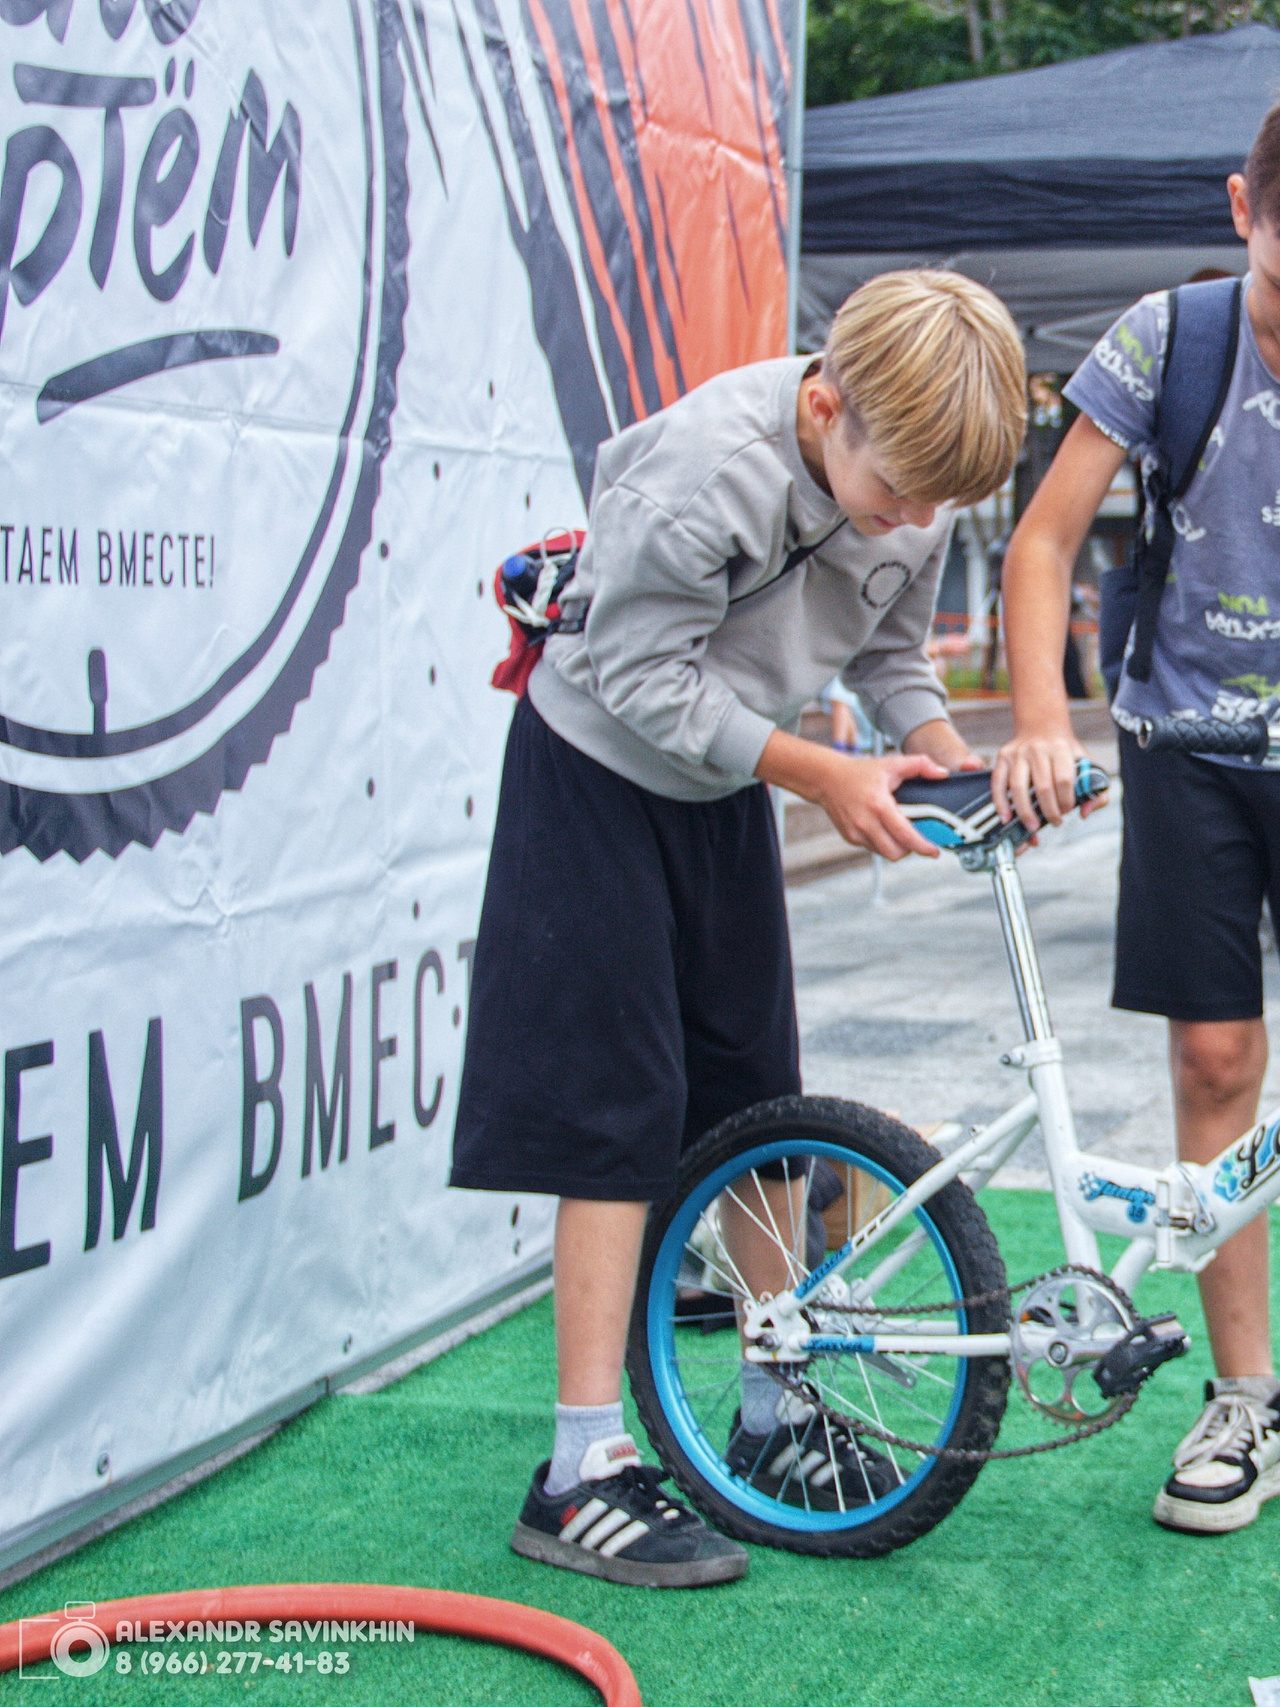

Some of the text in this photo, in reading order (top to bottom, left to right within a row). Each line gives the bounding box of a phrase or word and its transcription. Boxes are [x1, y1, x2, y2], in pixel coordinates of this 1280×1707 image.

[0, 524, 214, 588] ТАЕМ ВМЕСТЕ!
[1218, 592, 1269, 616] FUN
[0, 1016, 163, 1279] ЕМ
